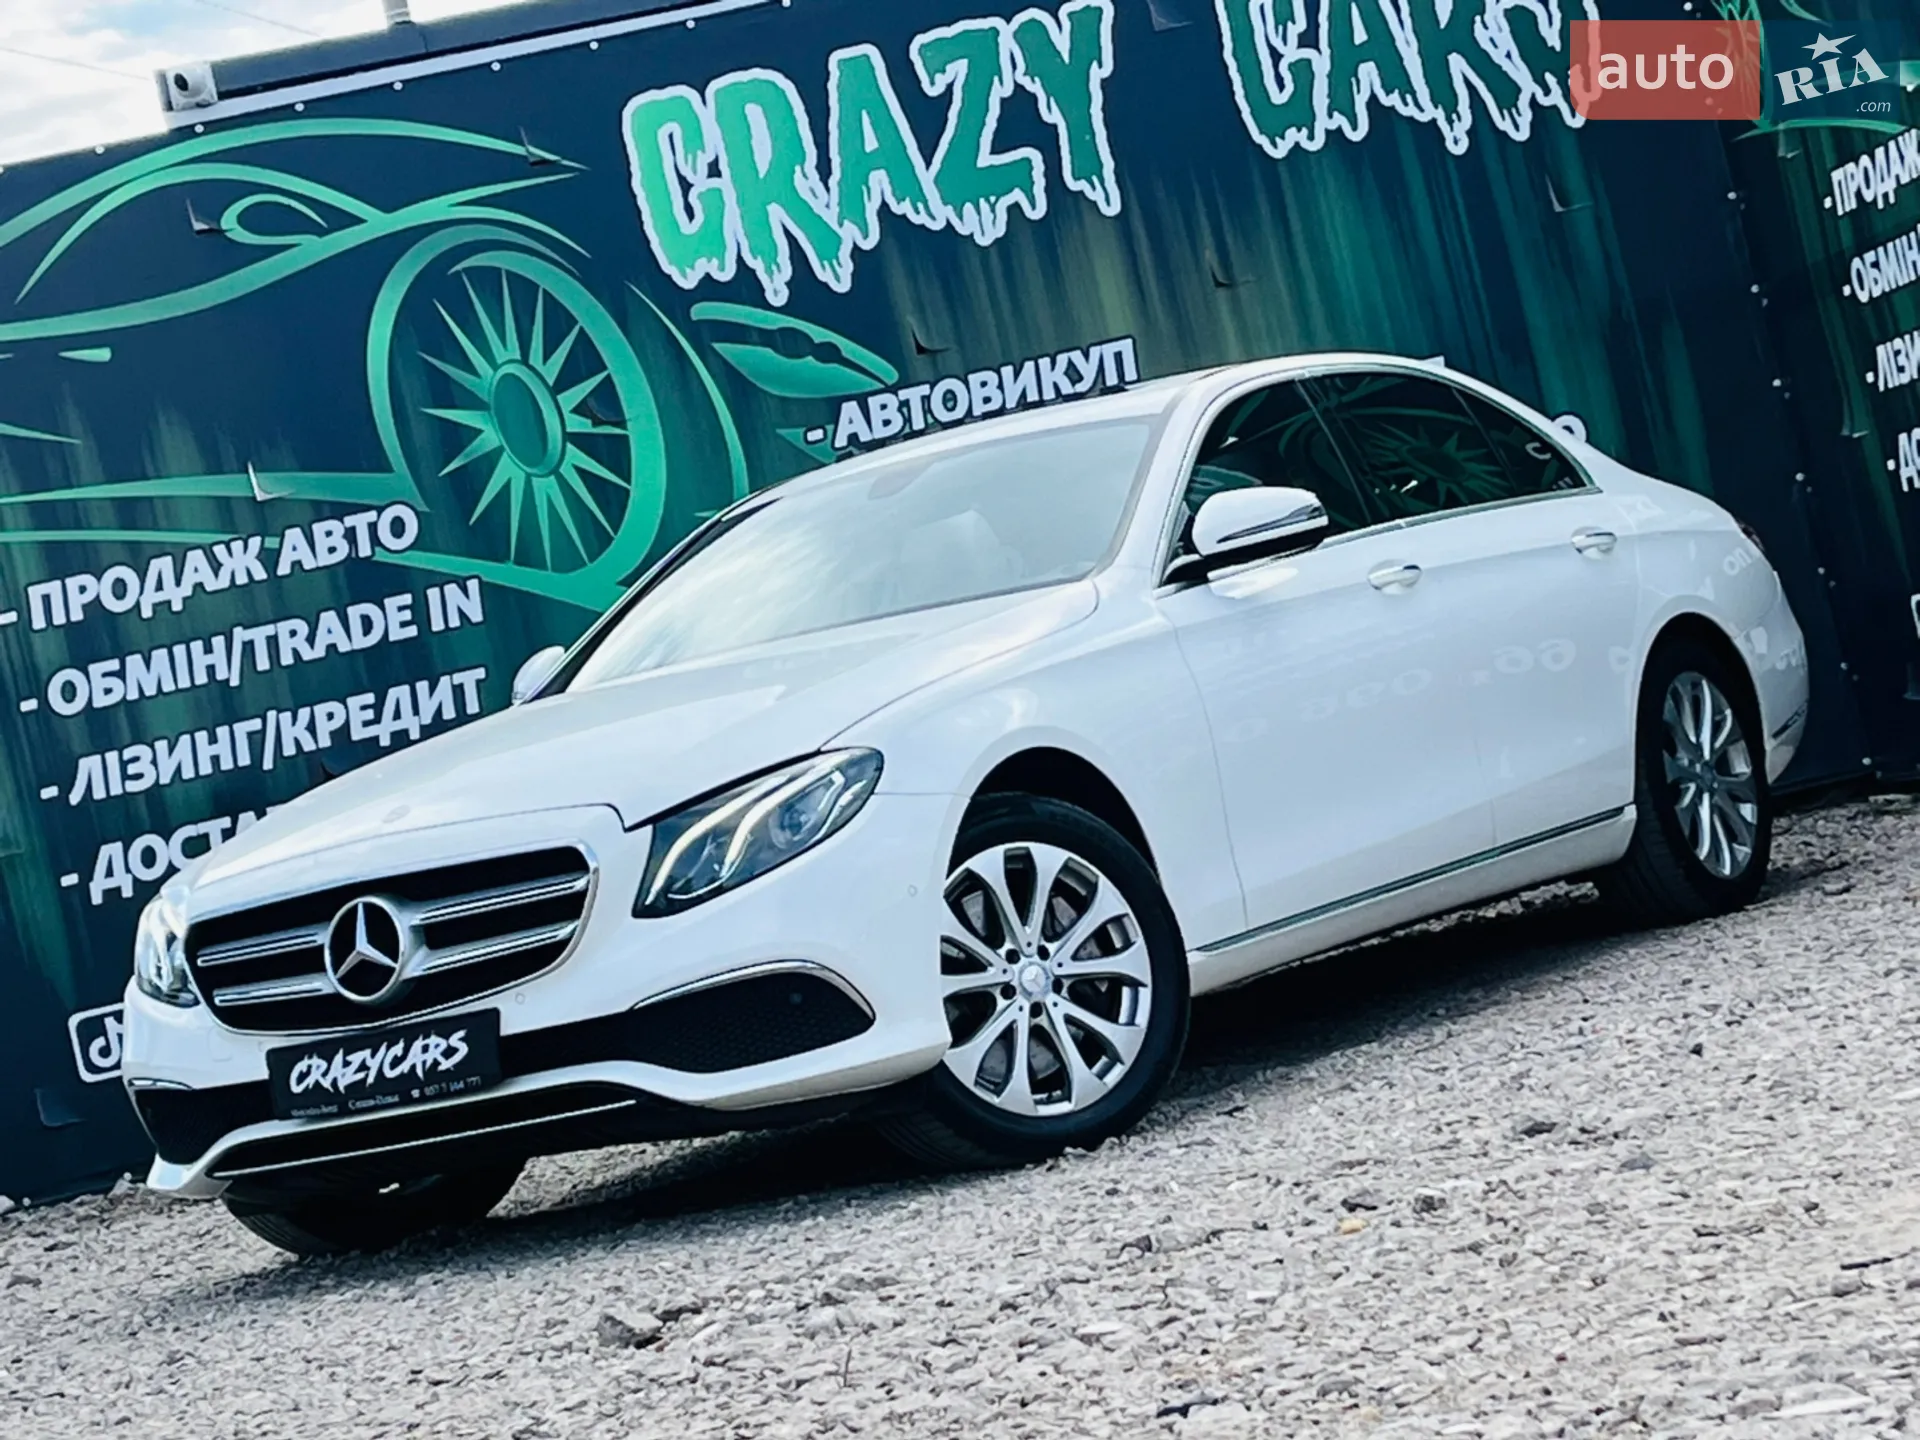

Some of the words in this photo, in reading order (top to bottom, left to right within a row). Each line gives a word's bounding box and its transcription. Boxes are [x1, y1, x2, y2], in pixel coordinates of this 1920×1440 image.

[622, 1, 1121, 306] CRAZY
[834, 338, 1138, 448] АВТОВИКУП
[27, 536, 268, 630] ПРОДАЖ
[276, 503, 419, 575] АВТО
[47, 594, 418, 716] ОБМІН/TRADE
[426, 577, 484, 632] IN
[69, 667, 487, 805] ЛІЗИНГ/КРЕДИТ
